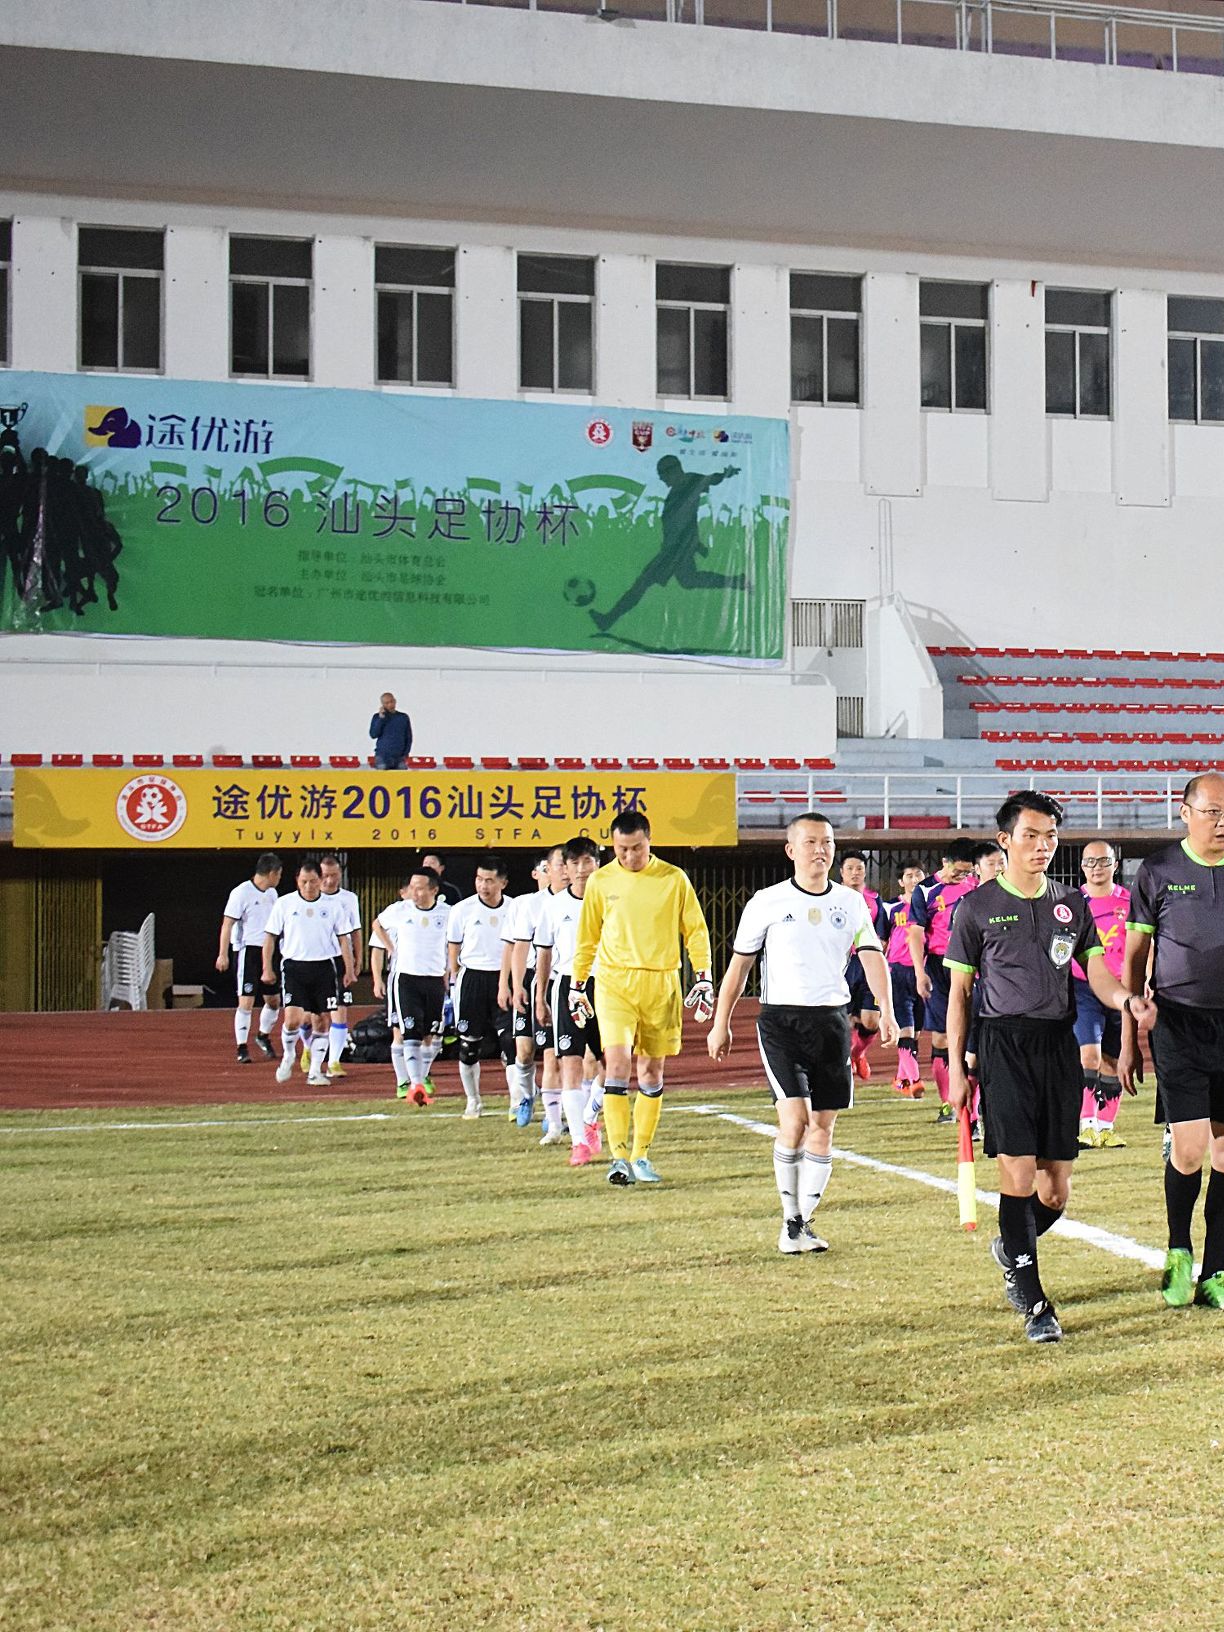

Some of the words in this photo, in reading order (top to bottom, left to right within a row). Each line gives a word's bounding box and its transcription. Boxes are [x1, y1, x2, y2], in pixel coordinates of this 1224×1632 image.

[146, 413, 274, 455] 途优游
[156, 485, 290, 528] 2016
[316, 490, 580, 546] 汕头足协杯
[212, 783, 648, 820] 途优游2016汕头足协杯
[372, 828, 437, 841] 2016
[475, 828, 542, 840] STFA
[579, 828, 610, 840] CU
[935, 895, 946, 912] 3
[989, 914, 1019, 924] KELME
[326, 996, 338, 1010] 12
